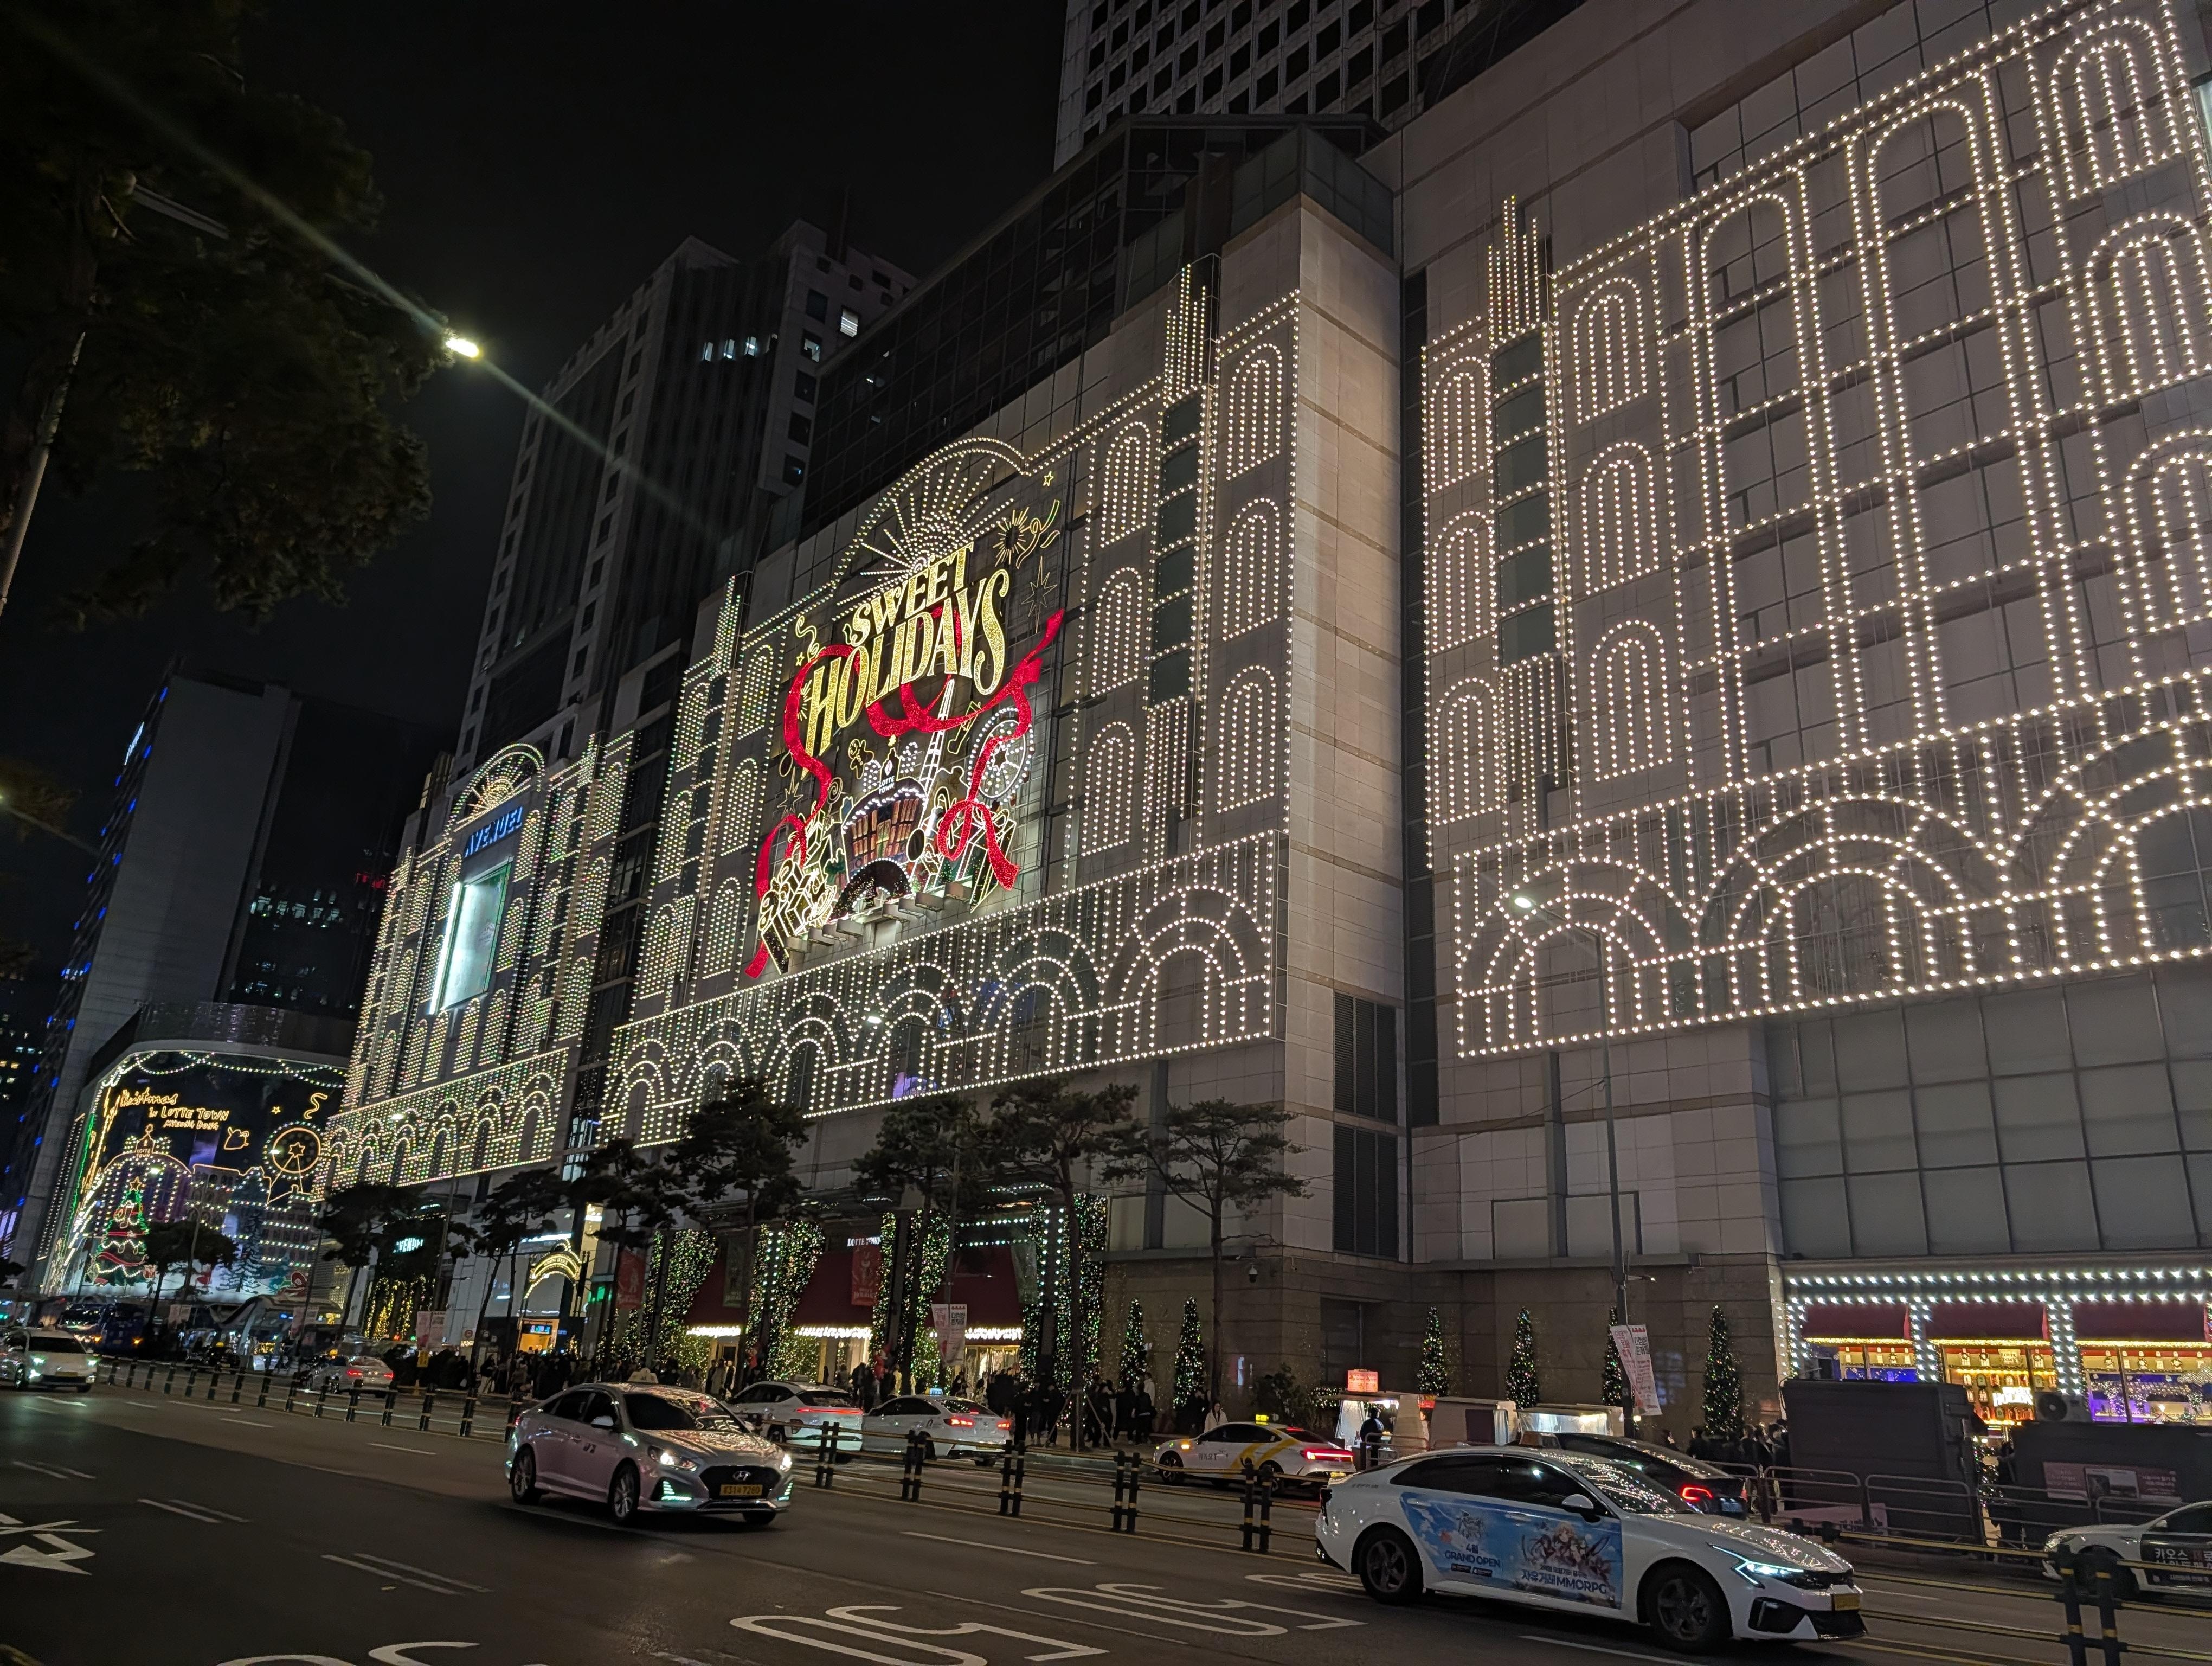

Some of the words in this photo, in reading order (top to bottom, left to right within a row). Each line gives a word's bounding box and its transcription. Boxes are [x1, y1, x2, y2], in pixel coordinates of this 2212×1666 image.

[851, 542, 975, 646] SWEET
[802, 569, 1009, 781] HOLIDAYS
[879, 776, 895, 786] LOTTE
[879, 783, 894, 794] TOWN
[465, 806, 523, 858] AVENUEL
[120, 1087, 178, 1107] Christmas
[161, 1106, 194, 1119] LOTTE
[196, 1107, 230, 1121] TOWN
[847, 1238, 865, 1247] LOTTE
[1444, 1550, 1475, 1563] GRAND
[1476, 1555, 1501, 1568] OPEN
[2155, 1548, 2189, 1560] 카오스
[1557, 1575, 1607, 1594] MMORPG
